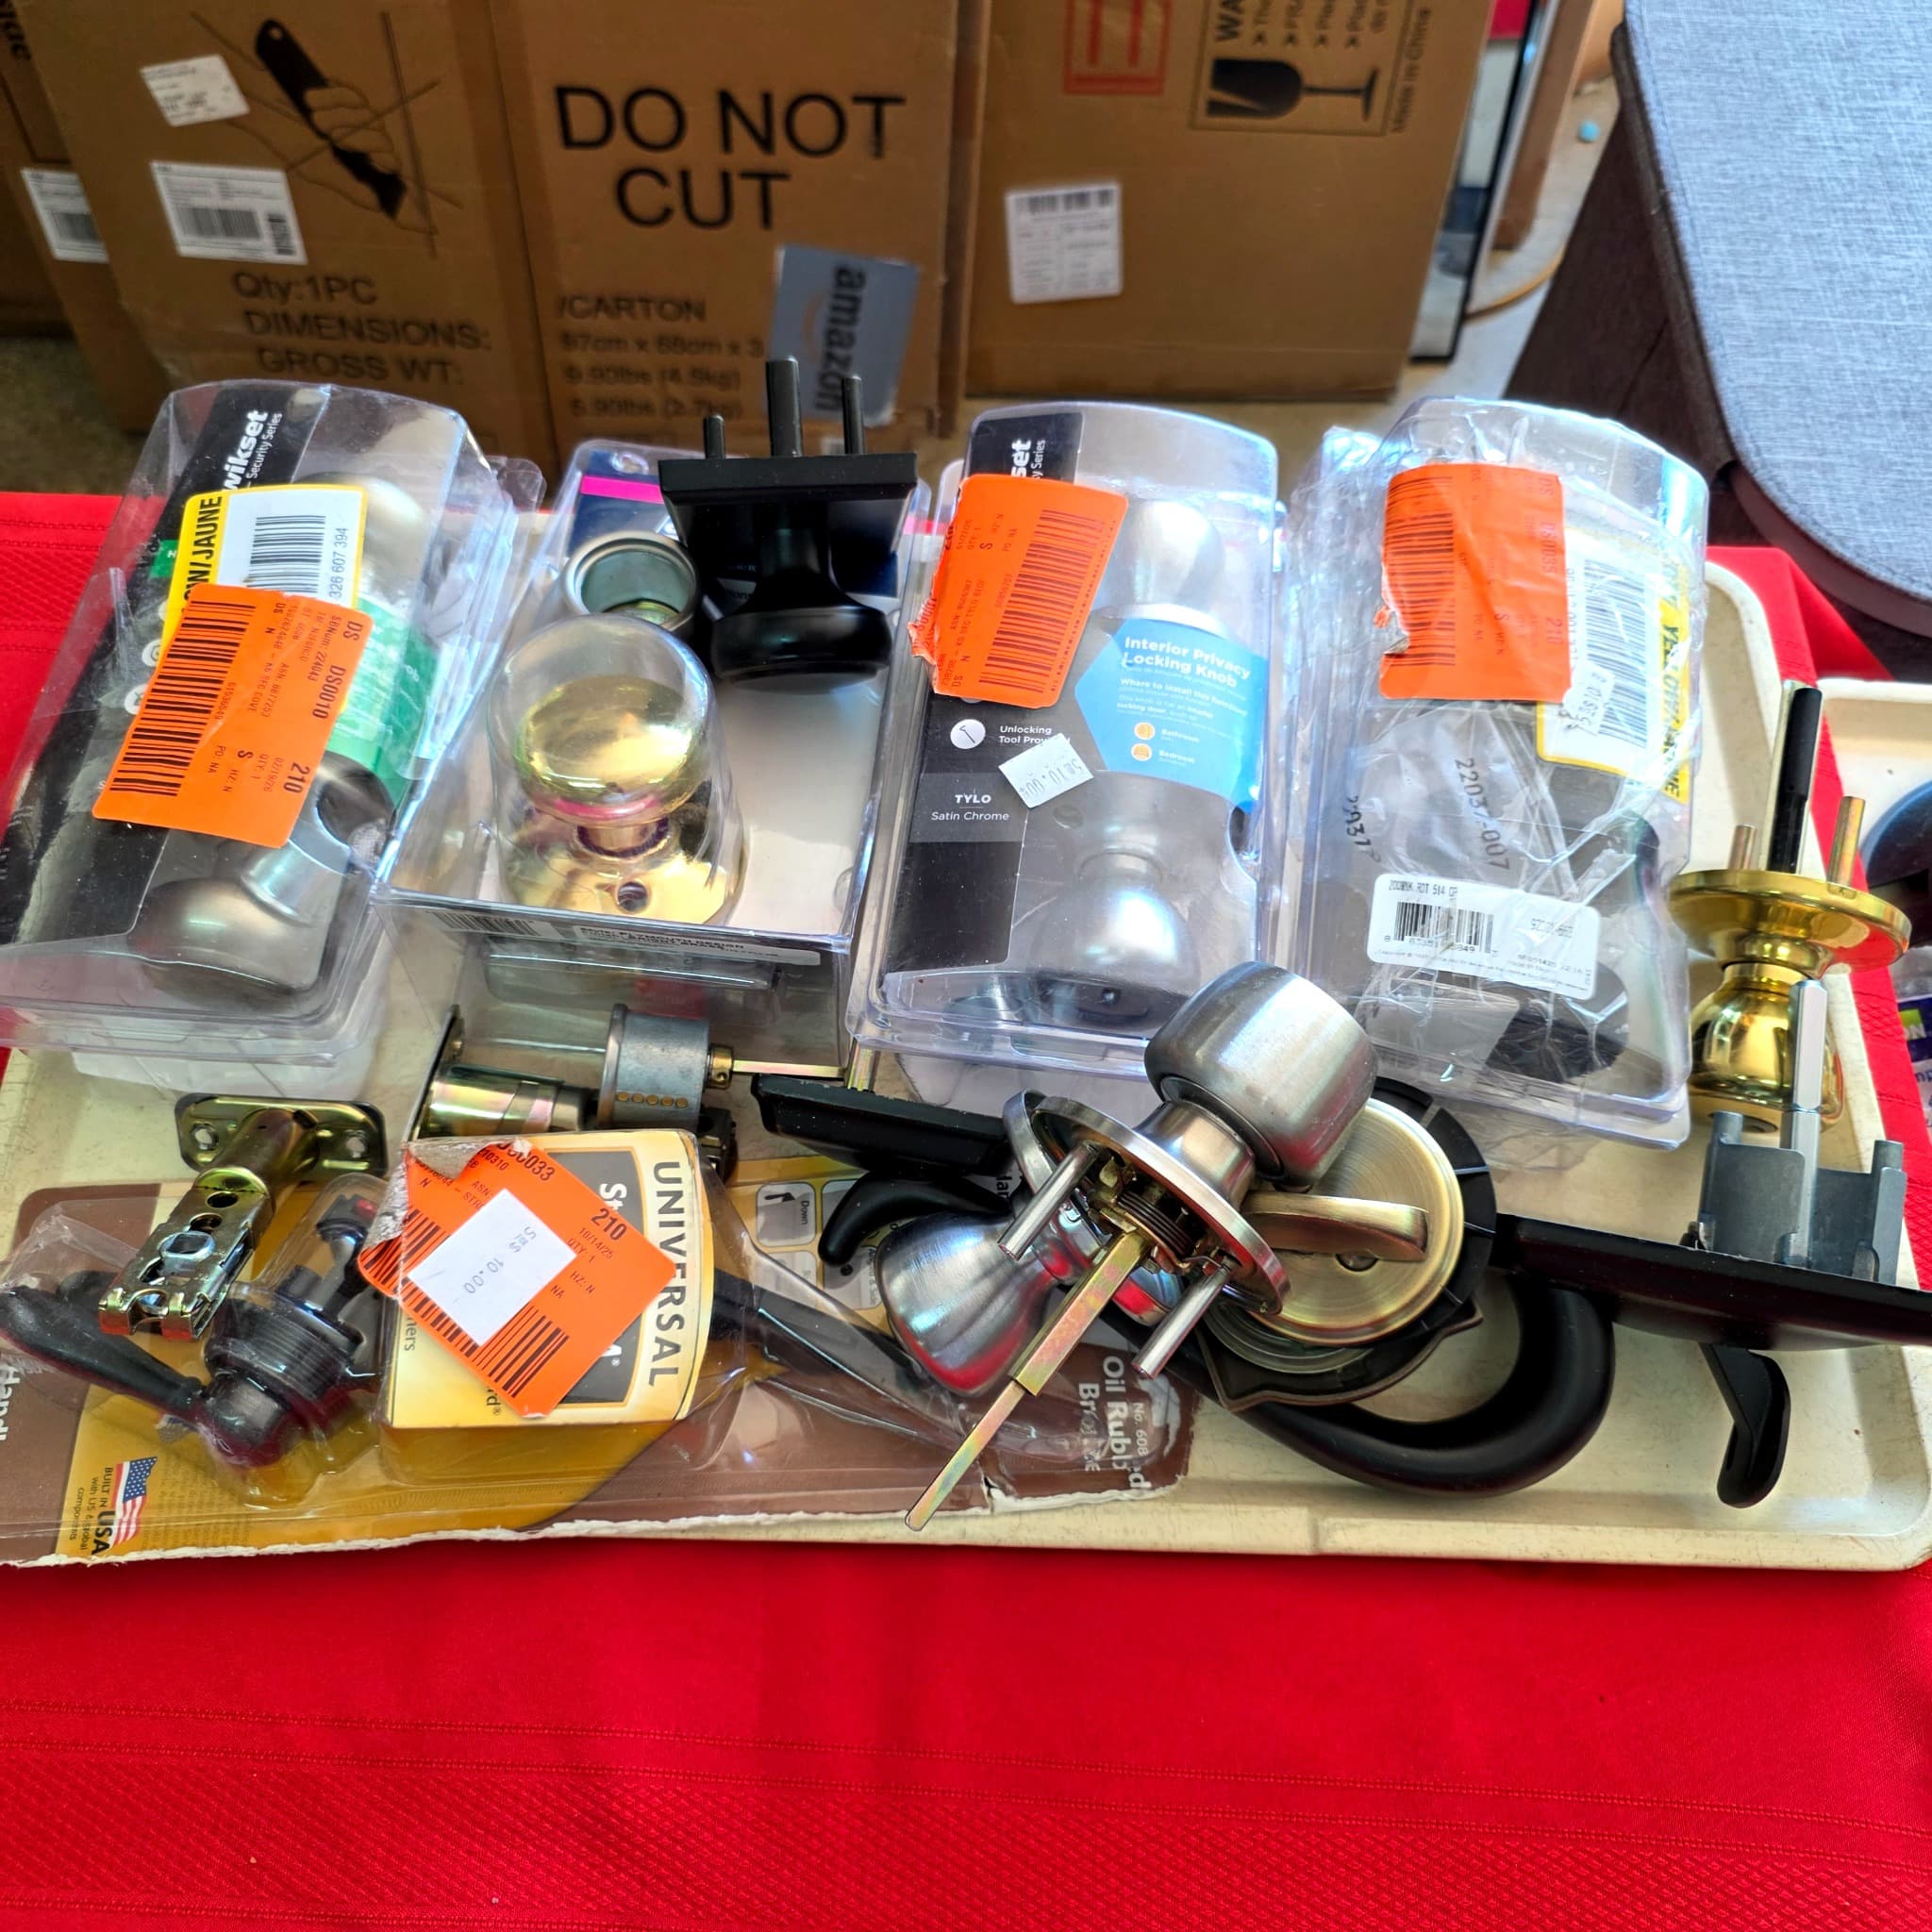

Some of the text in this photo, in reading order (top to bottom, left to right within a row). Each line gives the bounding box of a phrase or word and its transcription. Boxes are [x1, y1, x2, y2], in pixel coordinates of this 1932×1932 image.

[555, 86, 908, 158] DO NOT
[615, 166, 791, 230] CUT
[242, 309, 492, 352] DIMENSIONS:
[816, 266, 867, 412] amazon
[258, 346, 387, 382] GROSS
[246, 412, 283, 479] Security Series
[1030, 440, 1045, 470] Series
[335, 526, 349, 549] 394
[333, 552, 346, 575] 607
[1123, 652, 1192, 675] Locking
[1195, 663, 1240, 689] Knob
[1124, 636, 1251, 681] Interior Privacy
[282, 621, 363, 794] DS DS0010 210
[998, 735, 1022, 745] Tool
[999, 724, 1053, 737] Unlocking
[237, 750, 255, 760] S
[954, 793, 992, 805] TYLO
[930, 811, 1010, 823] Satin Chrome
[419, 1176, 431, 1189] N
[591, 1207, 628, 1242] 210
[800, 1199, 809, 1225] Down
[577, 1226, 616, 1260] 10/14/25
[462, 1257, 506, 1295] 10.00
[647, 1161, 689, 1389] UNIVERSAL
[1102, 1355, 1126, 1393] Oil
[1132, 1403, 1149, 1457] No. 608
[88, 1476, 98, 1495] with
[69, 1487, 85, 1541] components
[89, 1499, 96, 1513] US
[91, 1466, 117, 1556] BUILT IN USA
[80, 1521, 92, 1552] global
